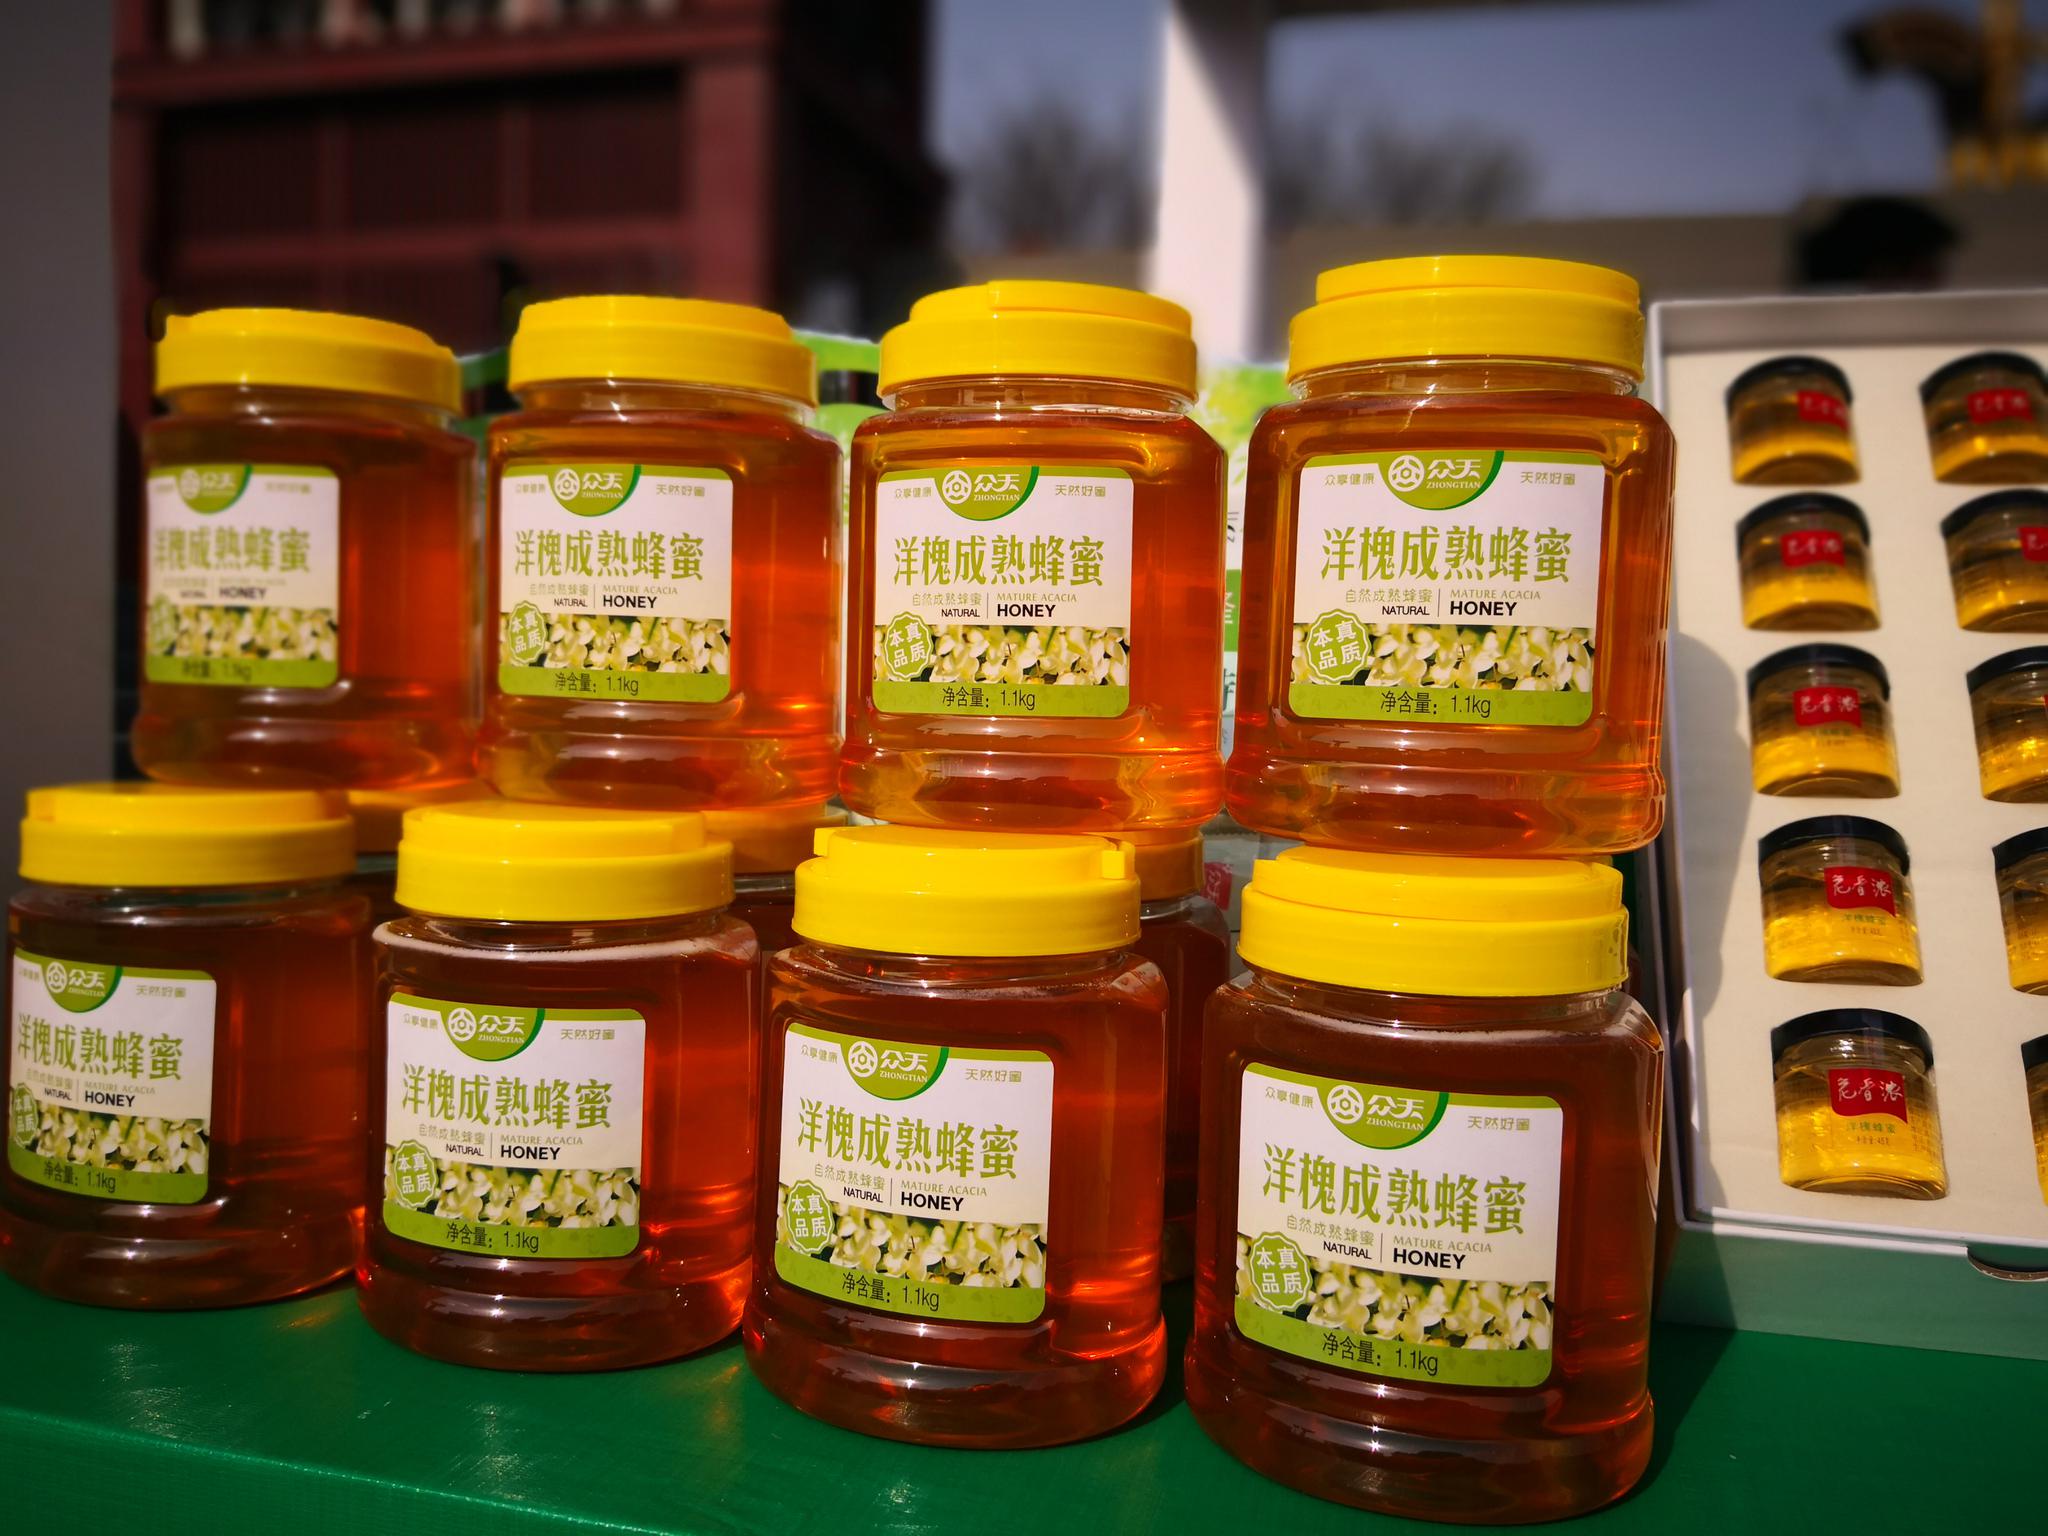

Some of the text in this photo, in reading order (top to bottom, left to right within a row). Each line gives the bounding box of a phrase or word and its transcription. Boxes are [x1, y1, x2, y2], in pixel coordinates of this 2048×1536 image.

[1427, 458, 1482, 479] 众天
[582, 472, 623, 490] 众天
[974, 473, 1020, 492] 众天
[1426, 481, 1481, 489] ZHONGTIAN
[1520, 470, 1576, 486] 天然好蜜
[581, 490, 624, 499] ZHONGTIAN
[515, 529, 704, 580] 洋槐成熟蜂蜜
[893, 534, 1105, 587] 洋槐成熟蜂蜜
[1320, 525, 1573, 583] 洋槐成熟蜂蜜
[220, 586, 267, 600] HONEY
[603, 584, 678, 595] MATURE ACACIA
[997, 593, 1077, 603] MATURE ACACIA
[1345, 588, 1433, 604] 自然成熟蜂蜜
[1450, 589, 1542, 600] MATURE ACACIA
[553, 598, 588, 607] NATURAL
[603, 595, 657, 609] HONEY
[996, 604, 1056, 618] HONEY
[1381, 605, 1430, 616] NATURAL
[1450, 600, 1518, 617] HONEY
[941, 608, 980, 618] NATURAL
[1318, 641, 1362, 671] 品质
[606, 677, 639, 695] 1.1kg
[1000, 689, 1036, 711] 1.1kg
[1451, 694, 1491, 718] 1.1kg
[68, 968, 105, 989] 众天
[478, 1014, 525, 1035] 众天
[18, 1011, 183, 1081] 洋槐成熟蜂蜜
[478, 1034, 525, 1044] ZHONGTIAN
[880, 1049, 929, 1074] 众天
[880, 1070, 929, 1083] ZHONGTIAN
[44, 1087, 72, 1101] NATURAL
[122, 1083, 156, 1095] ACACIA
[401, 1062, 613, 1130] 洋槐成熟蜂蜜
[85, 1091, 135, 1108] HONEY
[1366, 1094, 1425, 1121] 众天
[1366, 1117, 1424, 1131] ZHONGTIAN
[501, 1134, 583, 1145] MATURE ACACIA
[797, 1096, 1020, 1180] 洋槐成熟蜂蜜
[445, 1144, 485, 1157] NATURAL
[501, 1146, 561, 1161] HONEY
[87, 1172, 116, 1193] 1.1kg
[901, 1180, 988, 1196] MATURE ACACIA
[1263, 1141, 1527, 1235] 洋槐成熟蜂蜜
[843, 1186, 884, 1203] NATURAL
[900, 1192, 964, 1212] HONEY
[794, 1218, 828, 1238] 品质
[504, 1231, 540, 1253] 1.1kg
[1323, 1240, 1373, 1260] NATURAL
[1393, 1236, 1492, 1253] MATURE ACACIA
[1393, 1247, 1466, 1270] HONEY
[1261, 1272, 1304, 1295] 品质
[902, 1286, 940, 1311] 1.1kg
[1395, 1348, 1439, 1377] 1.1kg
